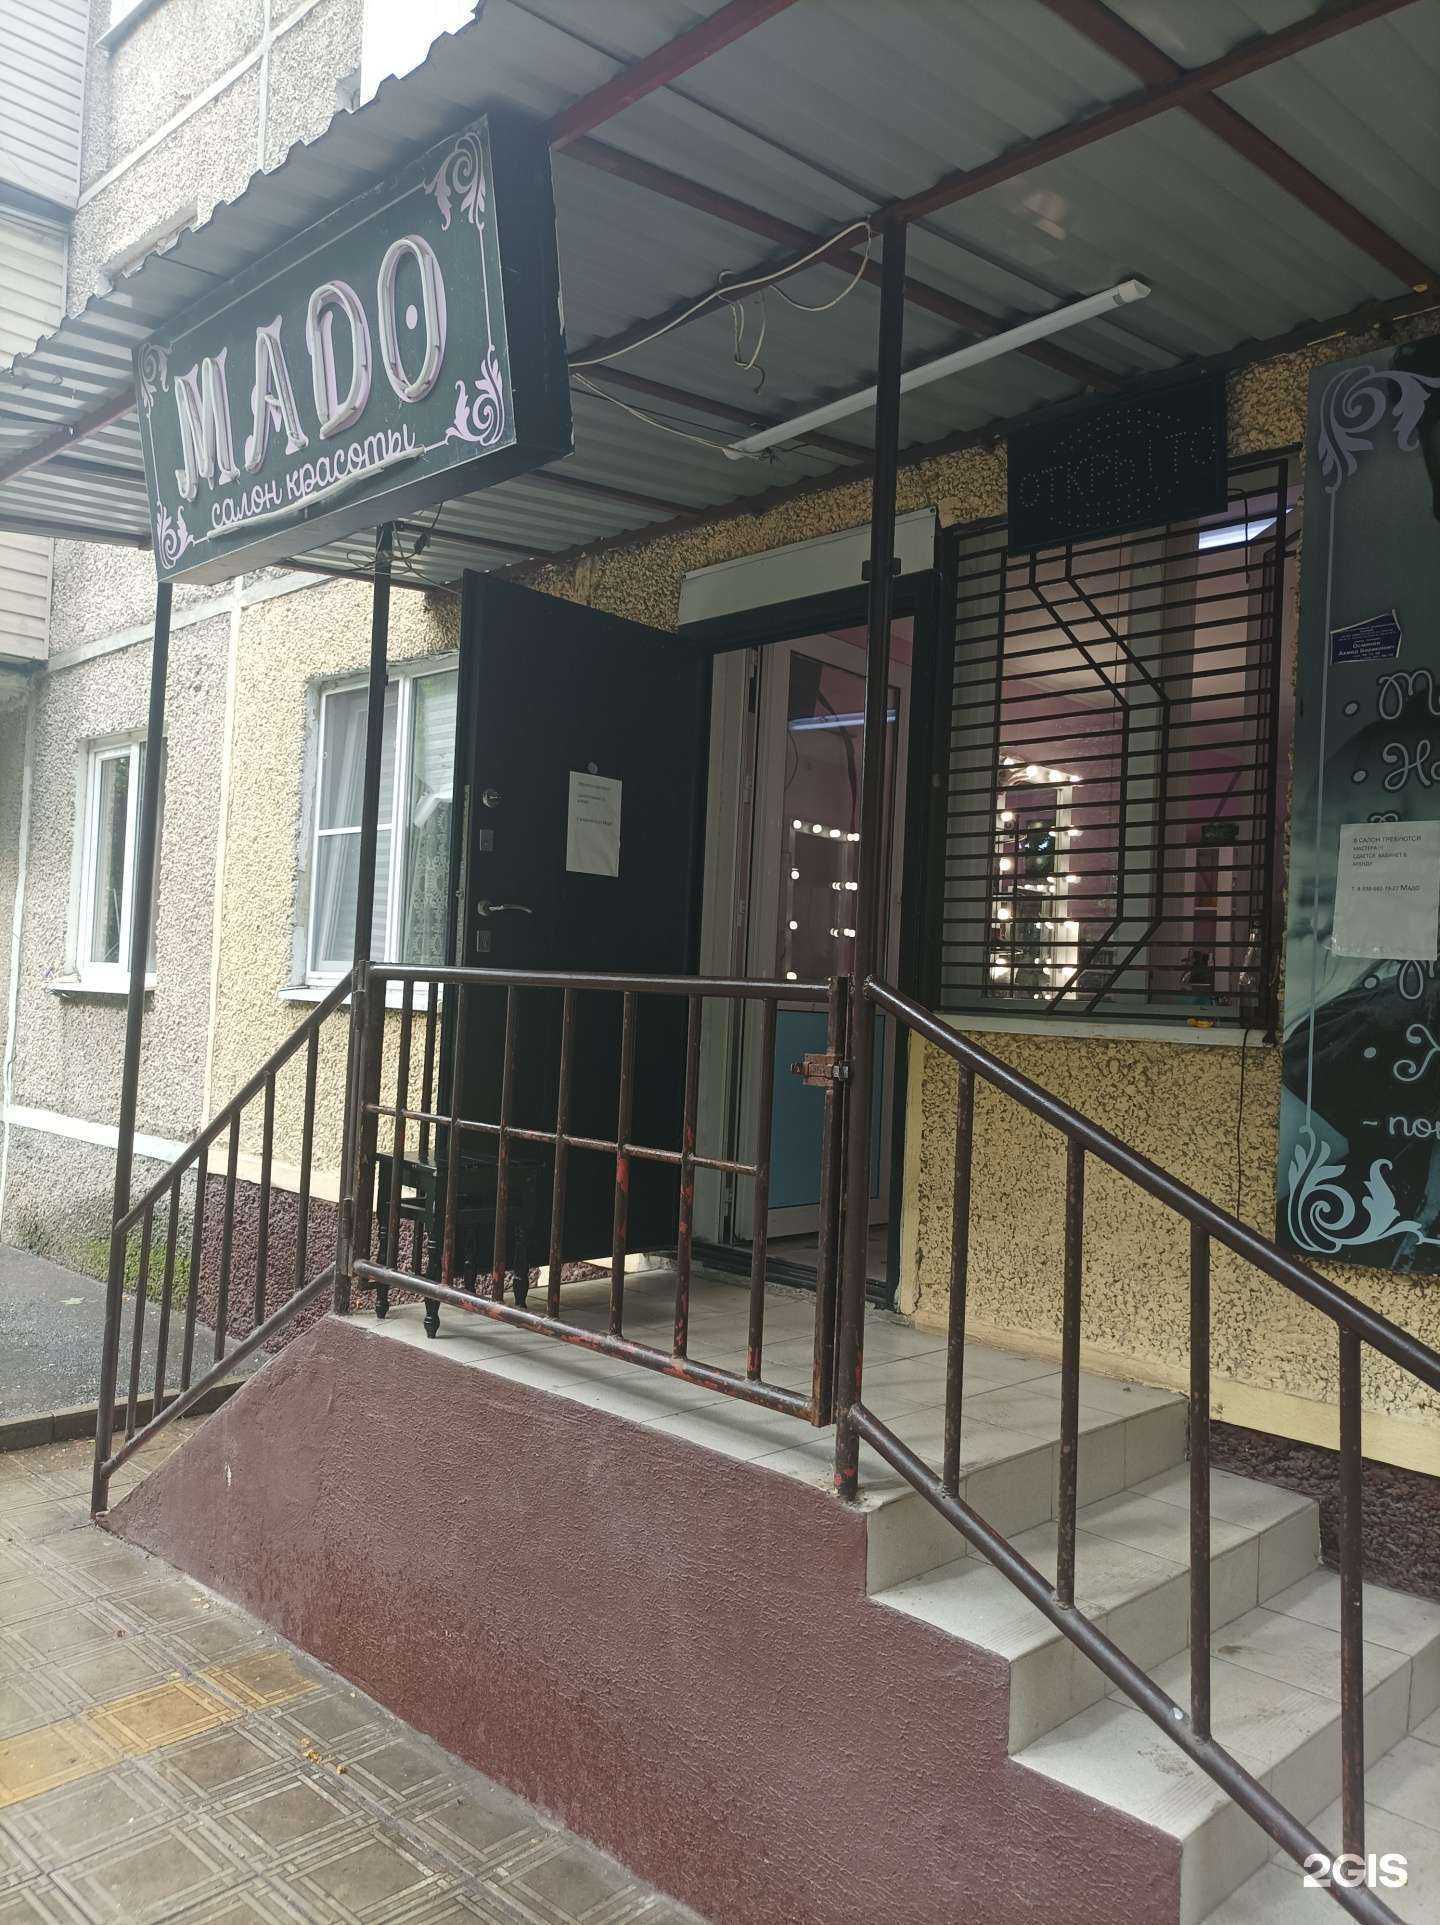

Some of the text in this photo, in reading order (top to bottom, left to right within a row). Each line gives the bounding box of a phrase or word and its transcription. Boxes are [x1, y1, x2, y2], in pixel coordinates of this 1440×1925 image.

[174, 234, 448, 502] MADO
[211, 423, 417, 529] салон красоты
